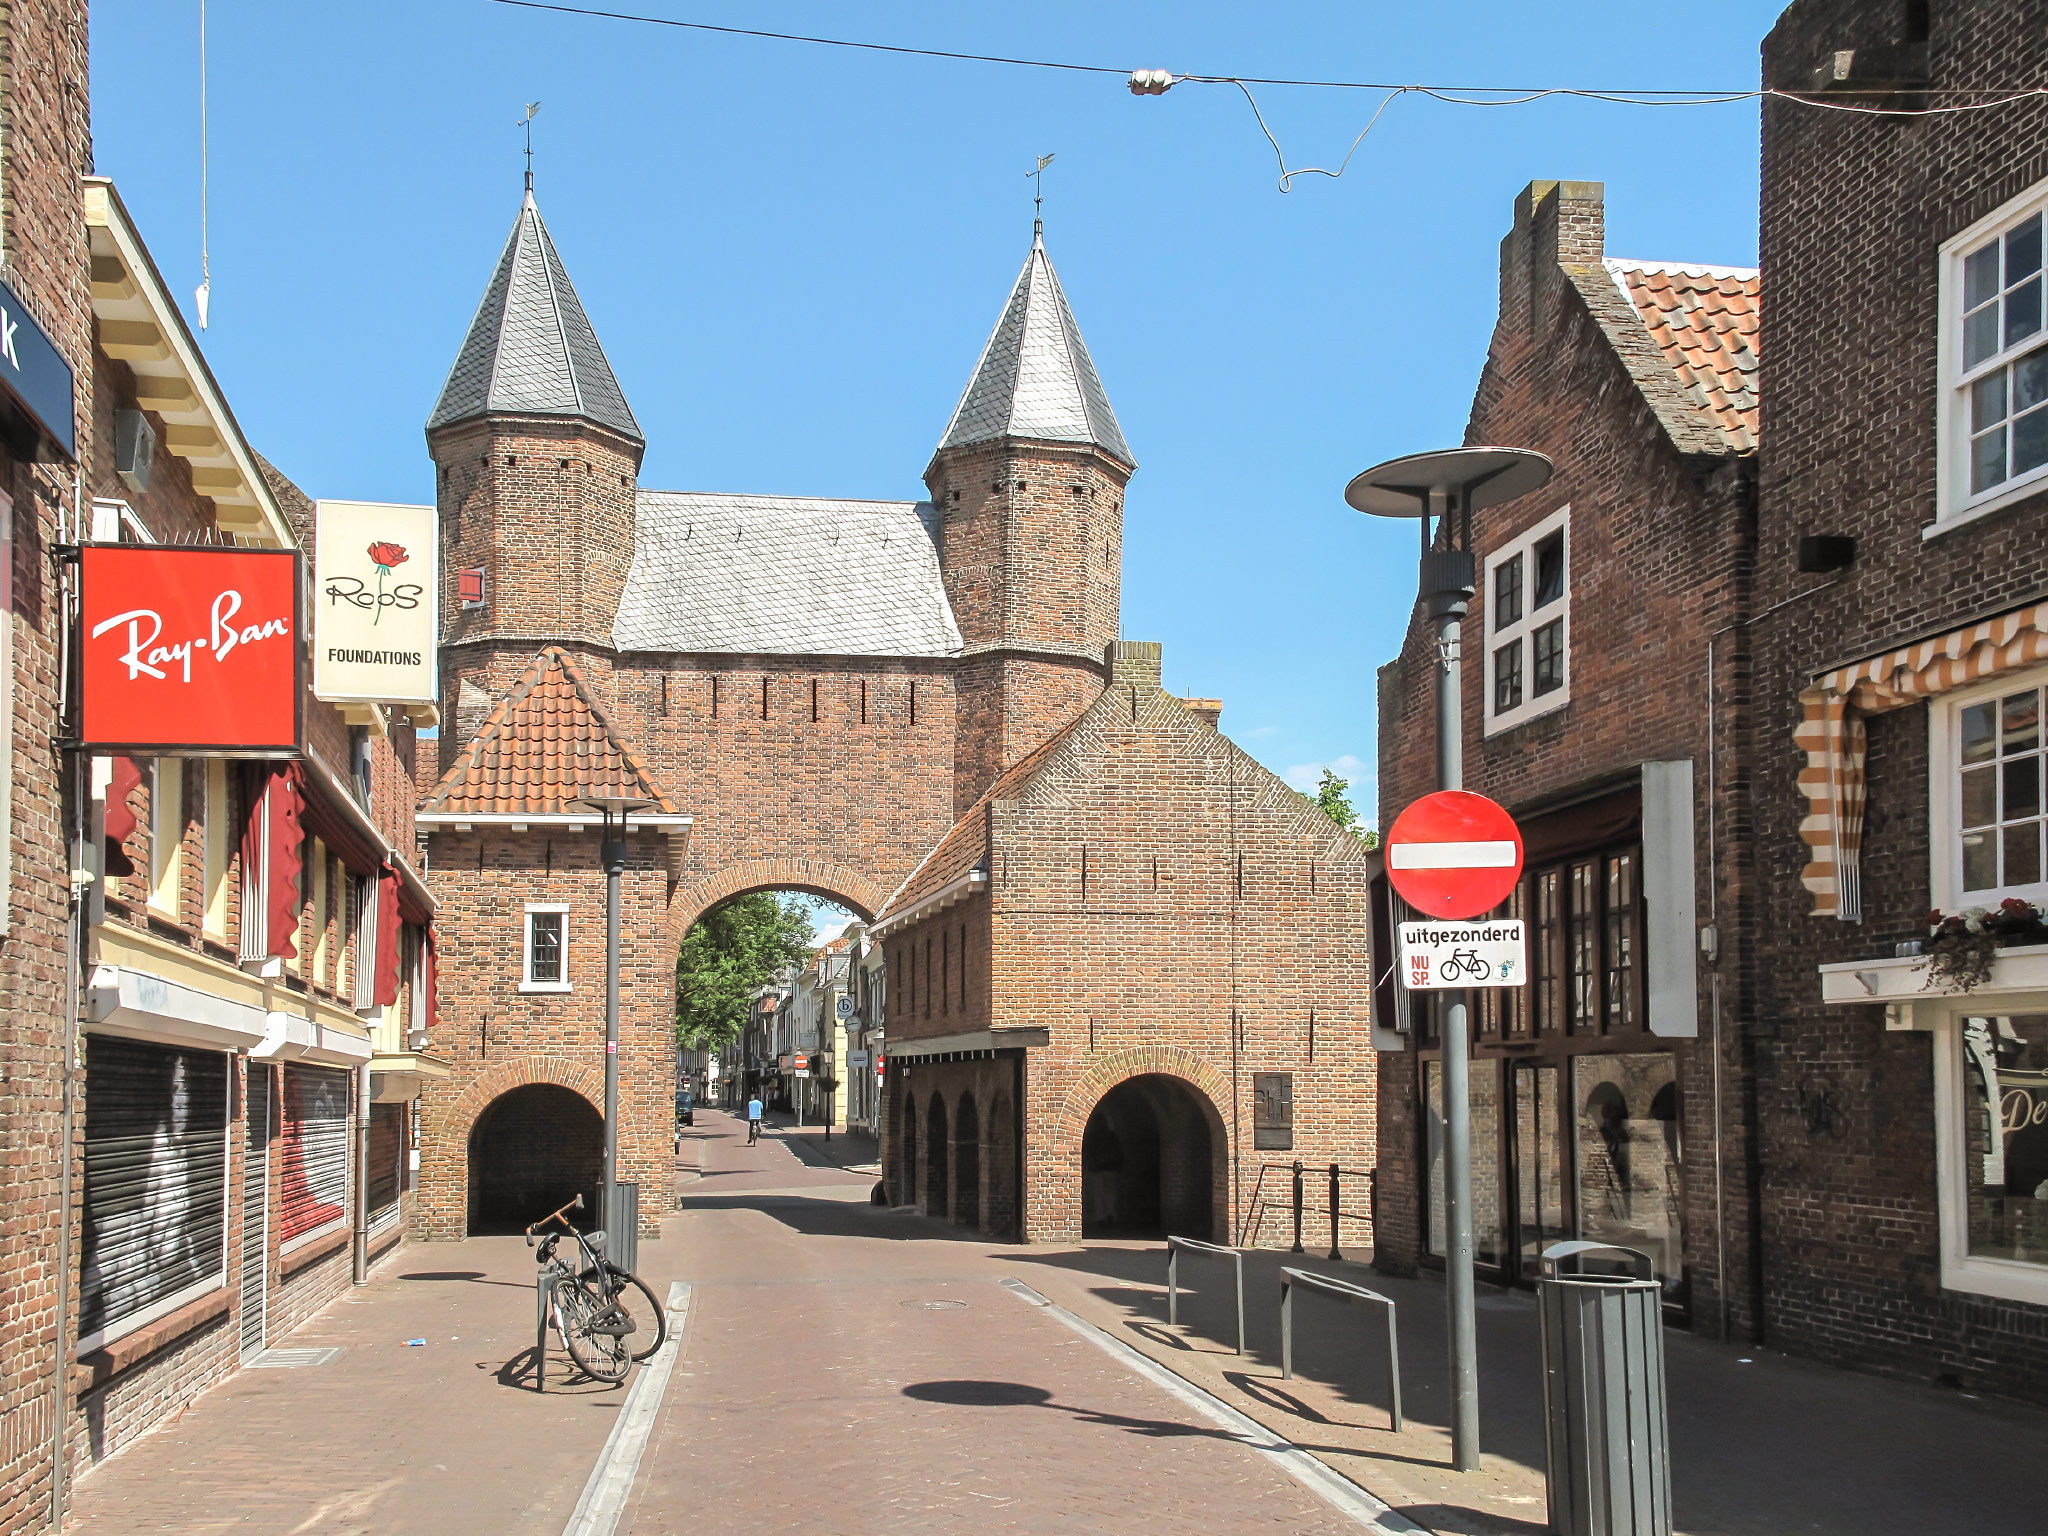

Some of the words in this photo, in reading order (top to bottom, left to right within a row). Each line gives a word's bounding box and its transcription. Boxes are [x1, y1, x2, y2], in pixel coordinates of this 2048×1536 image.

[92, 590, 288, 682] Ray-Ban
[328, 648, 422, 666] FOUNDATIONS
[1406, 926, 1520, 948] uitgezonderd
[1411, 955, 1429, 970] NU
